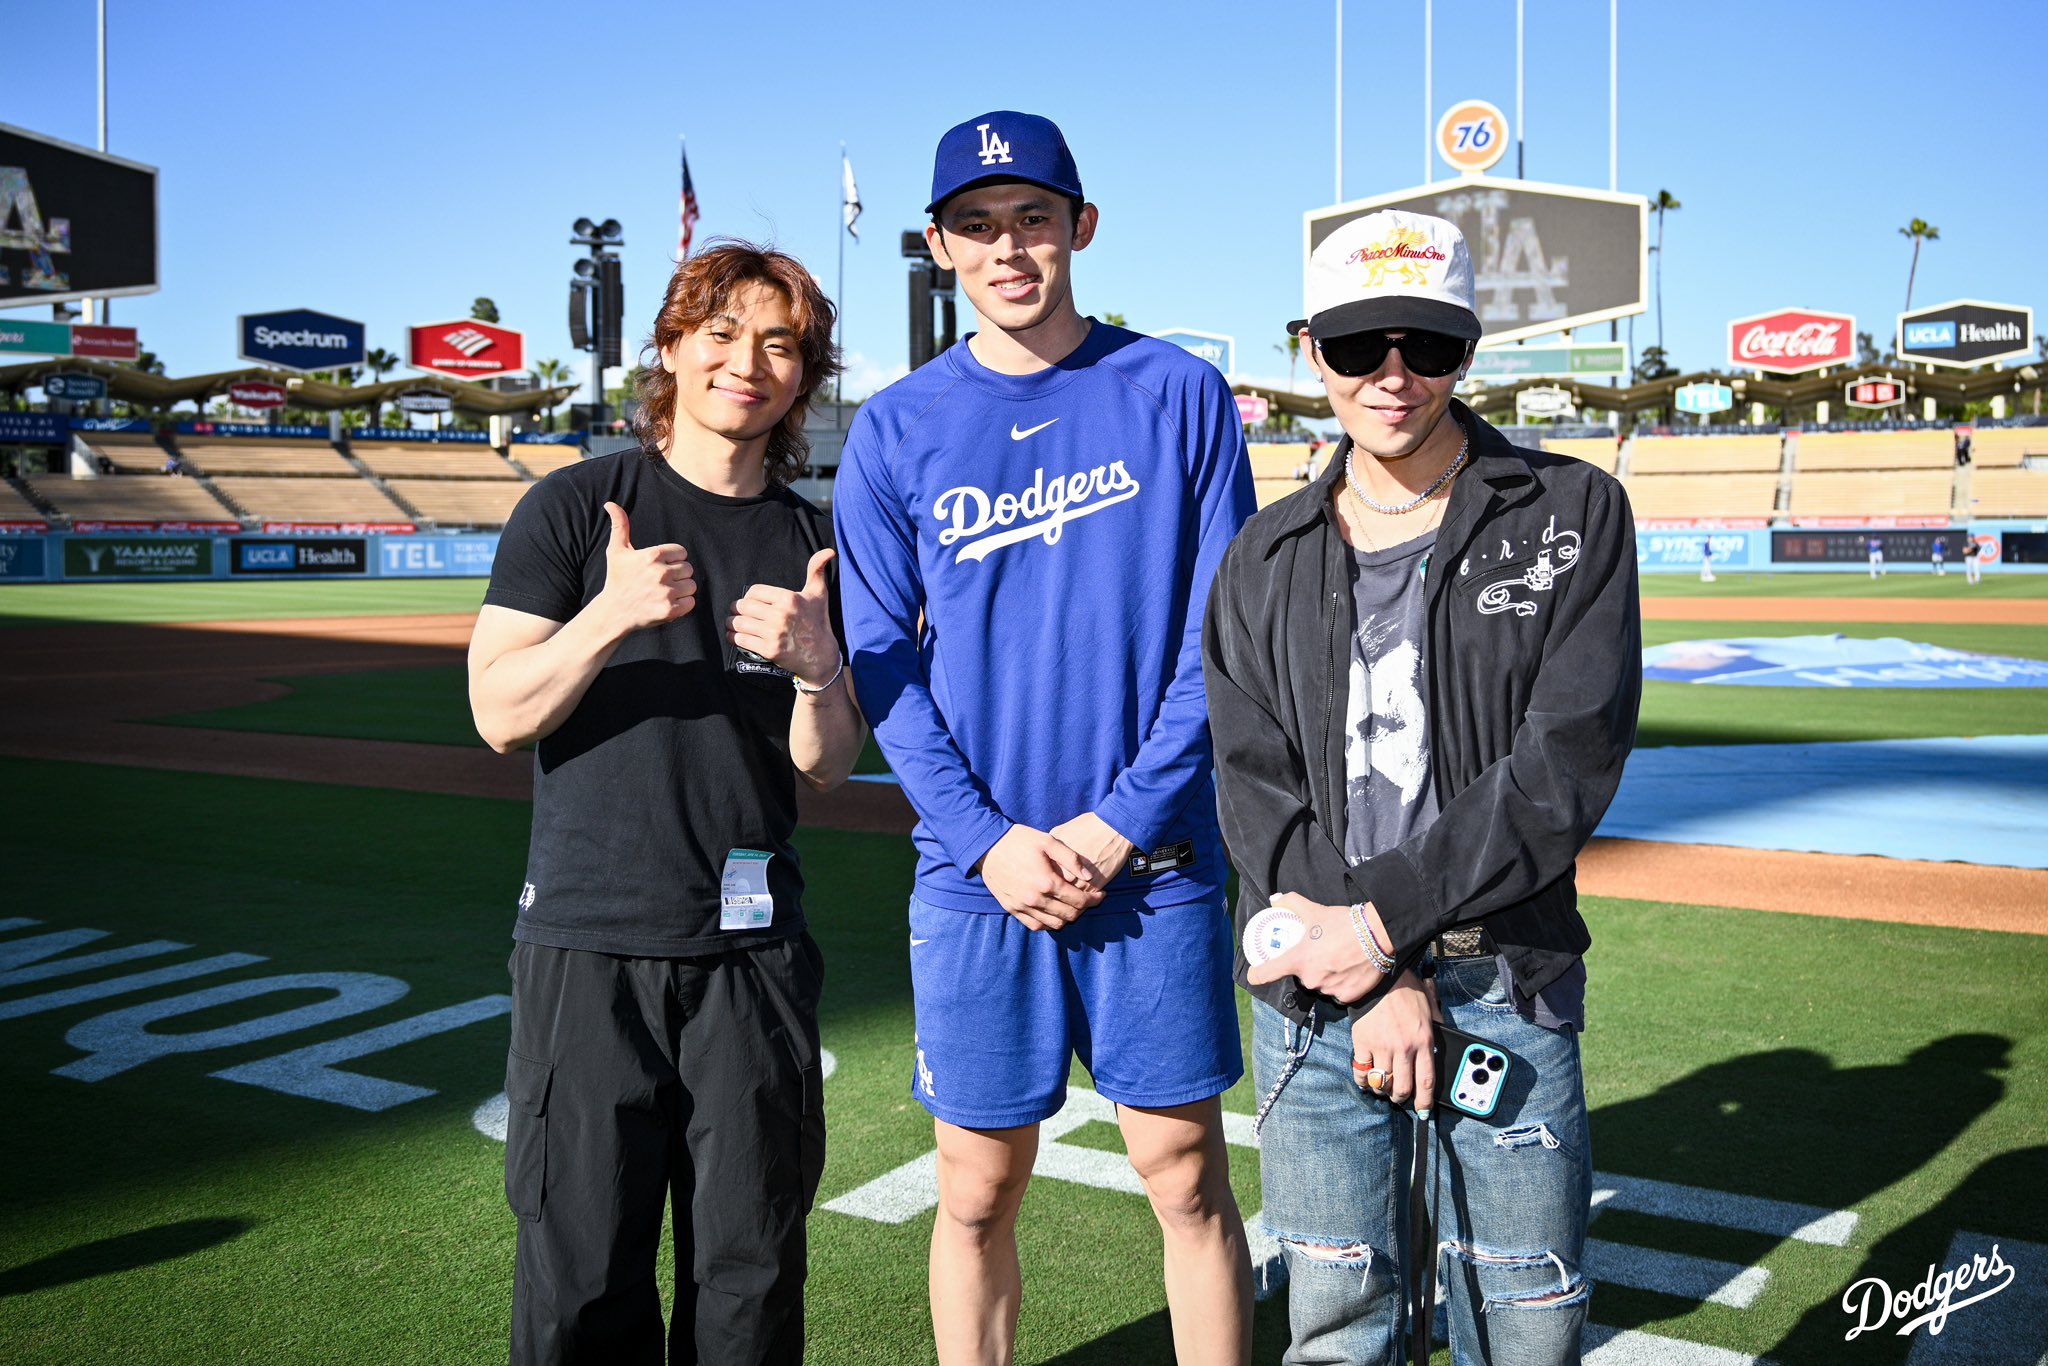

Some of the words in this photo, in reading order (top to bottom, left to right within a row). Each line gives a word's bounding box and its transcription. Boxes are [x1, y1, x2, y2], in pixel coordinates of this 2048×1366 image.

[976, 123, 1013, 166] LA
[1456, 120, 1493, 149] 76
[1907, 327, 1953, 344] UCLA
[1960, 321, 2021, 343] Health
[933, 460, 1140, 565] Dodgers
[247, 549, 289, 564] UCLA
[298, 547, 356, 565] Health
[385, 543, 445, 570] TEL
